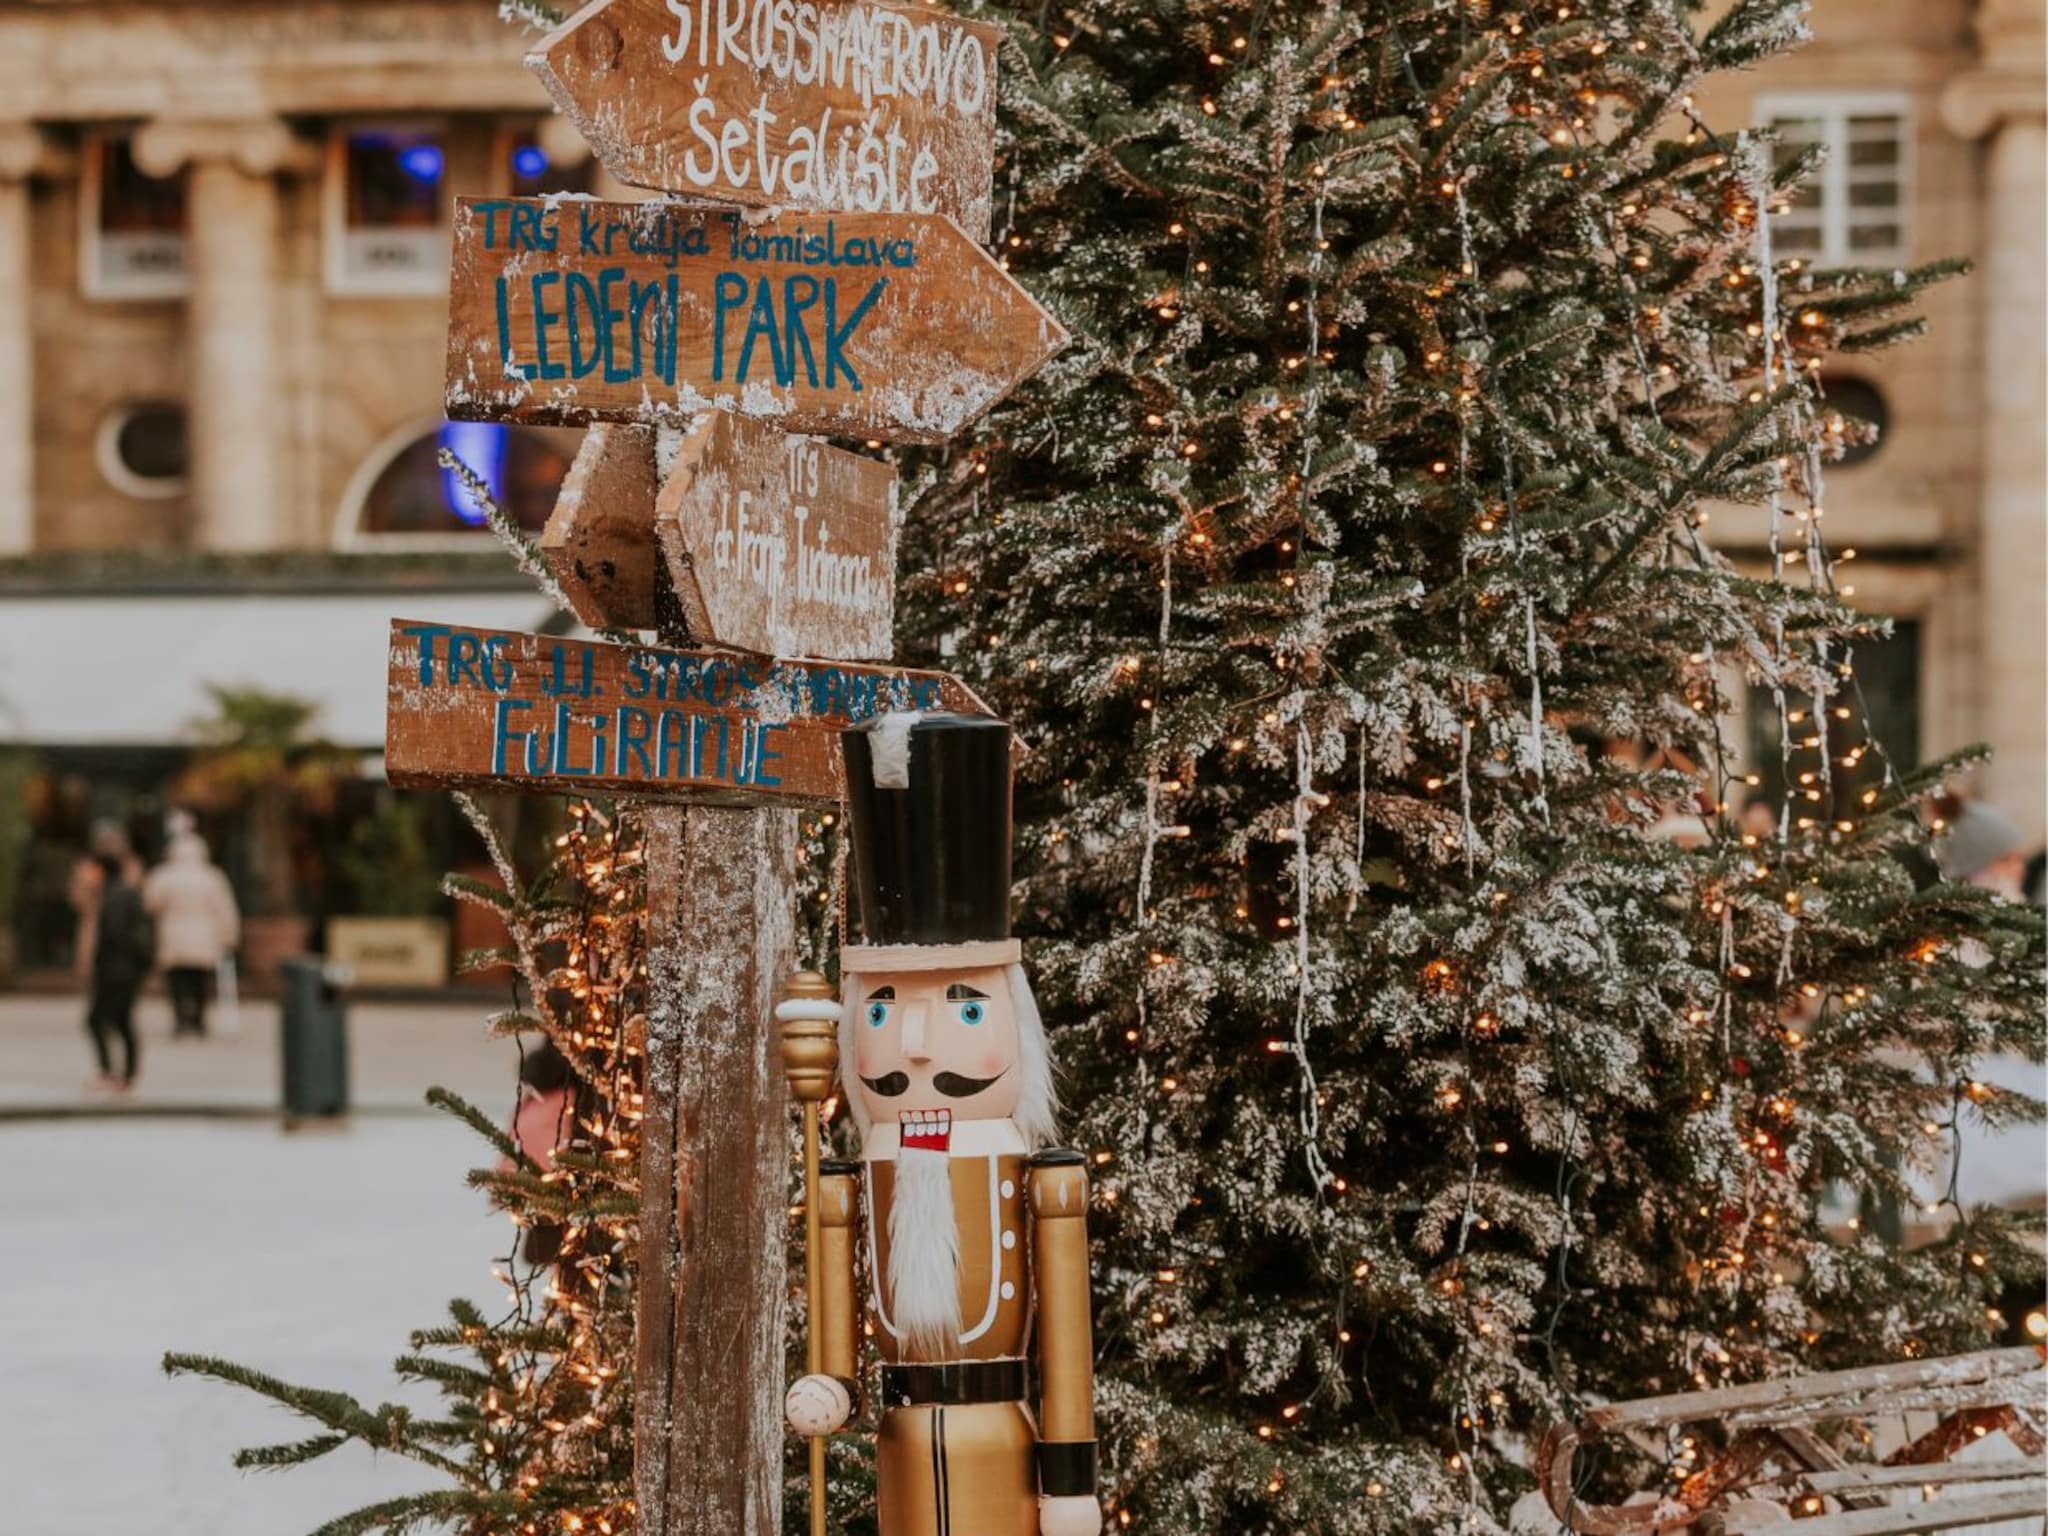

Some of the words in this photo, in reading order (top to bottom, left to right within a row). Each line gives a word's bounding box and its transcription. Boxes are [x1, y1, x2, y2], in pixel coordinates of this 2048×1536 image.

[684, 73, 941, 215] Šetalište
[473, 201, 560, 251] TRG
[579, 203, 709, 268] kralja
[719, 208, 918, 268] Tomislava
[712, 271, 890, 392] PARK
[403, 624, 514, 694] TRG
